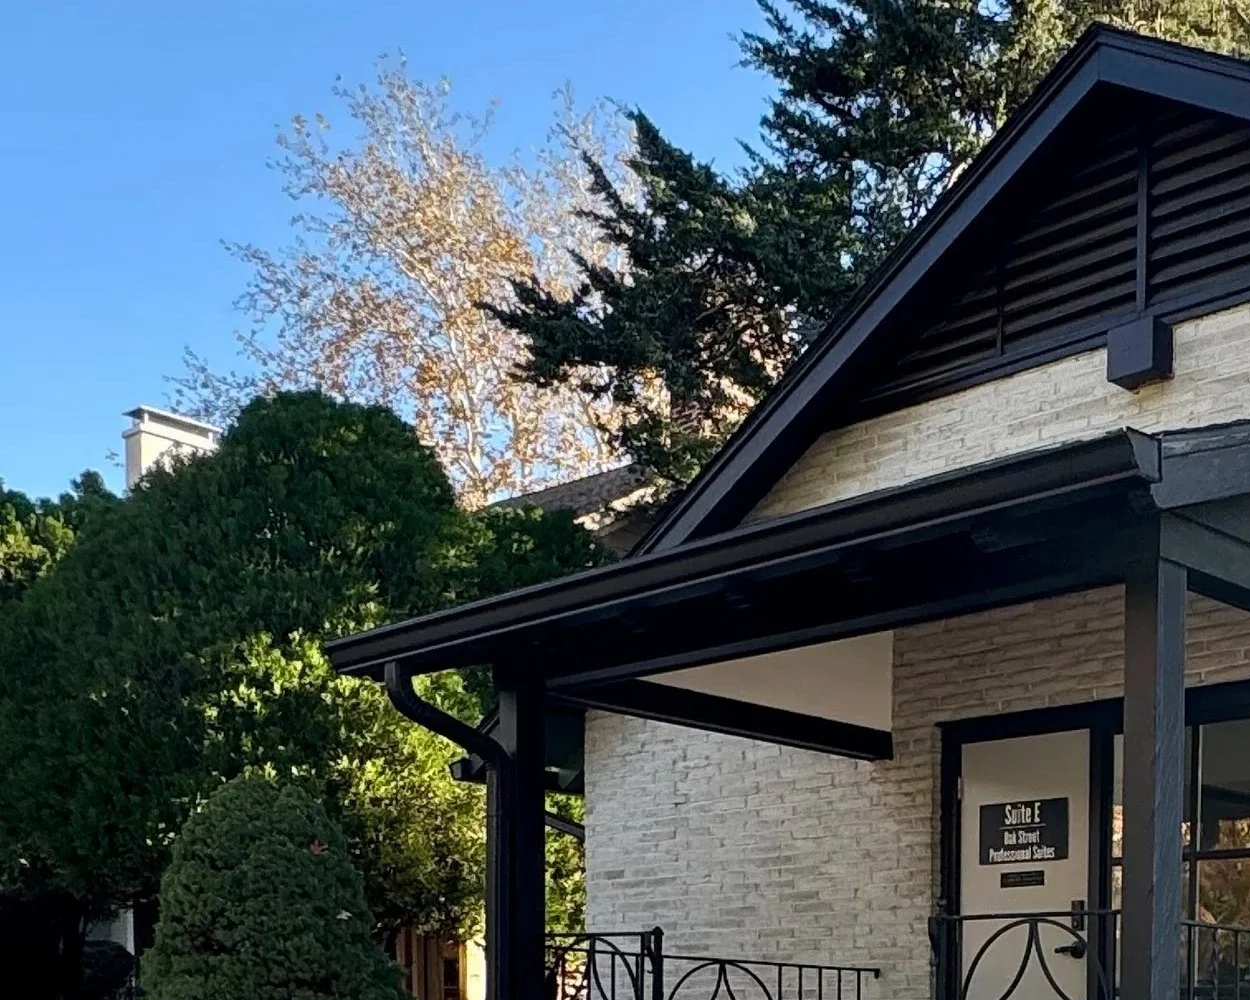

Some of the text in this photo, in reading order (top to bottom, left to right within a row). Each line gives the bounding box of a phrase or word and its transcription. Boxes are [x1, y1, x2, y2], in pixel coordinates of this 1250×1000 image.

[1004, 802, 1041, 825] Suite E
[1004, 831, 1017, 845] Oak
